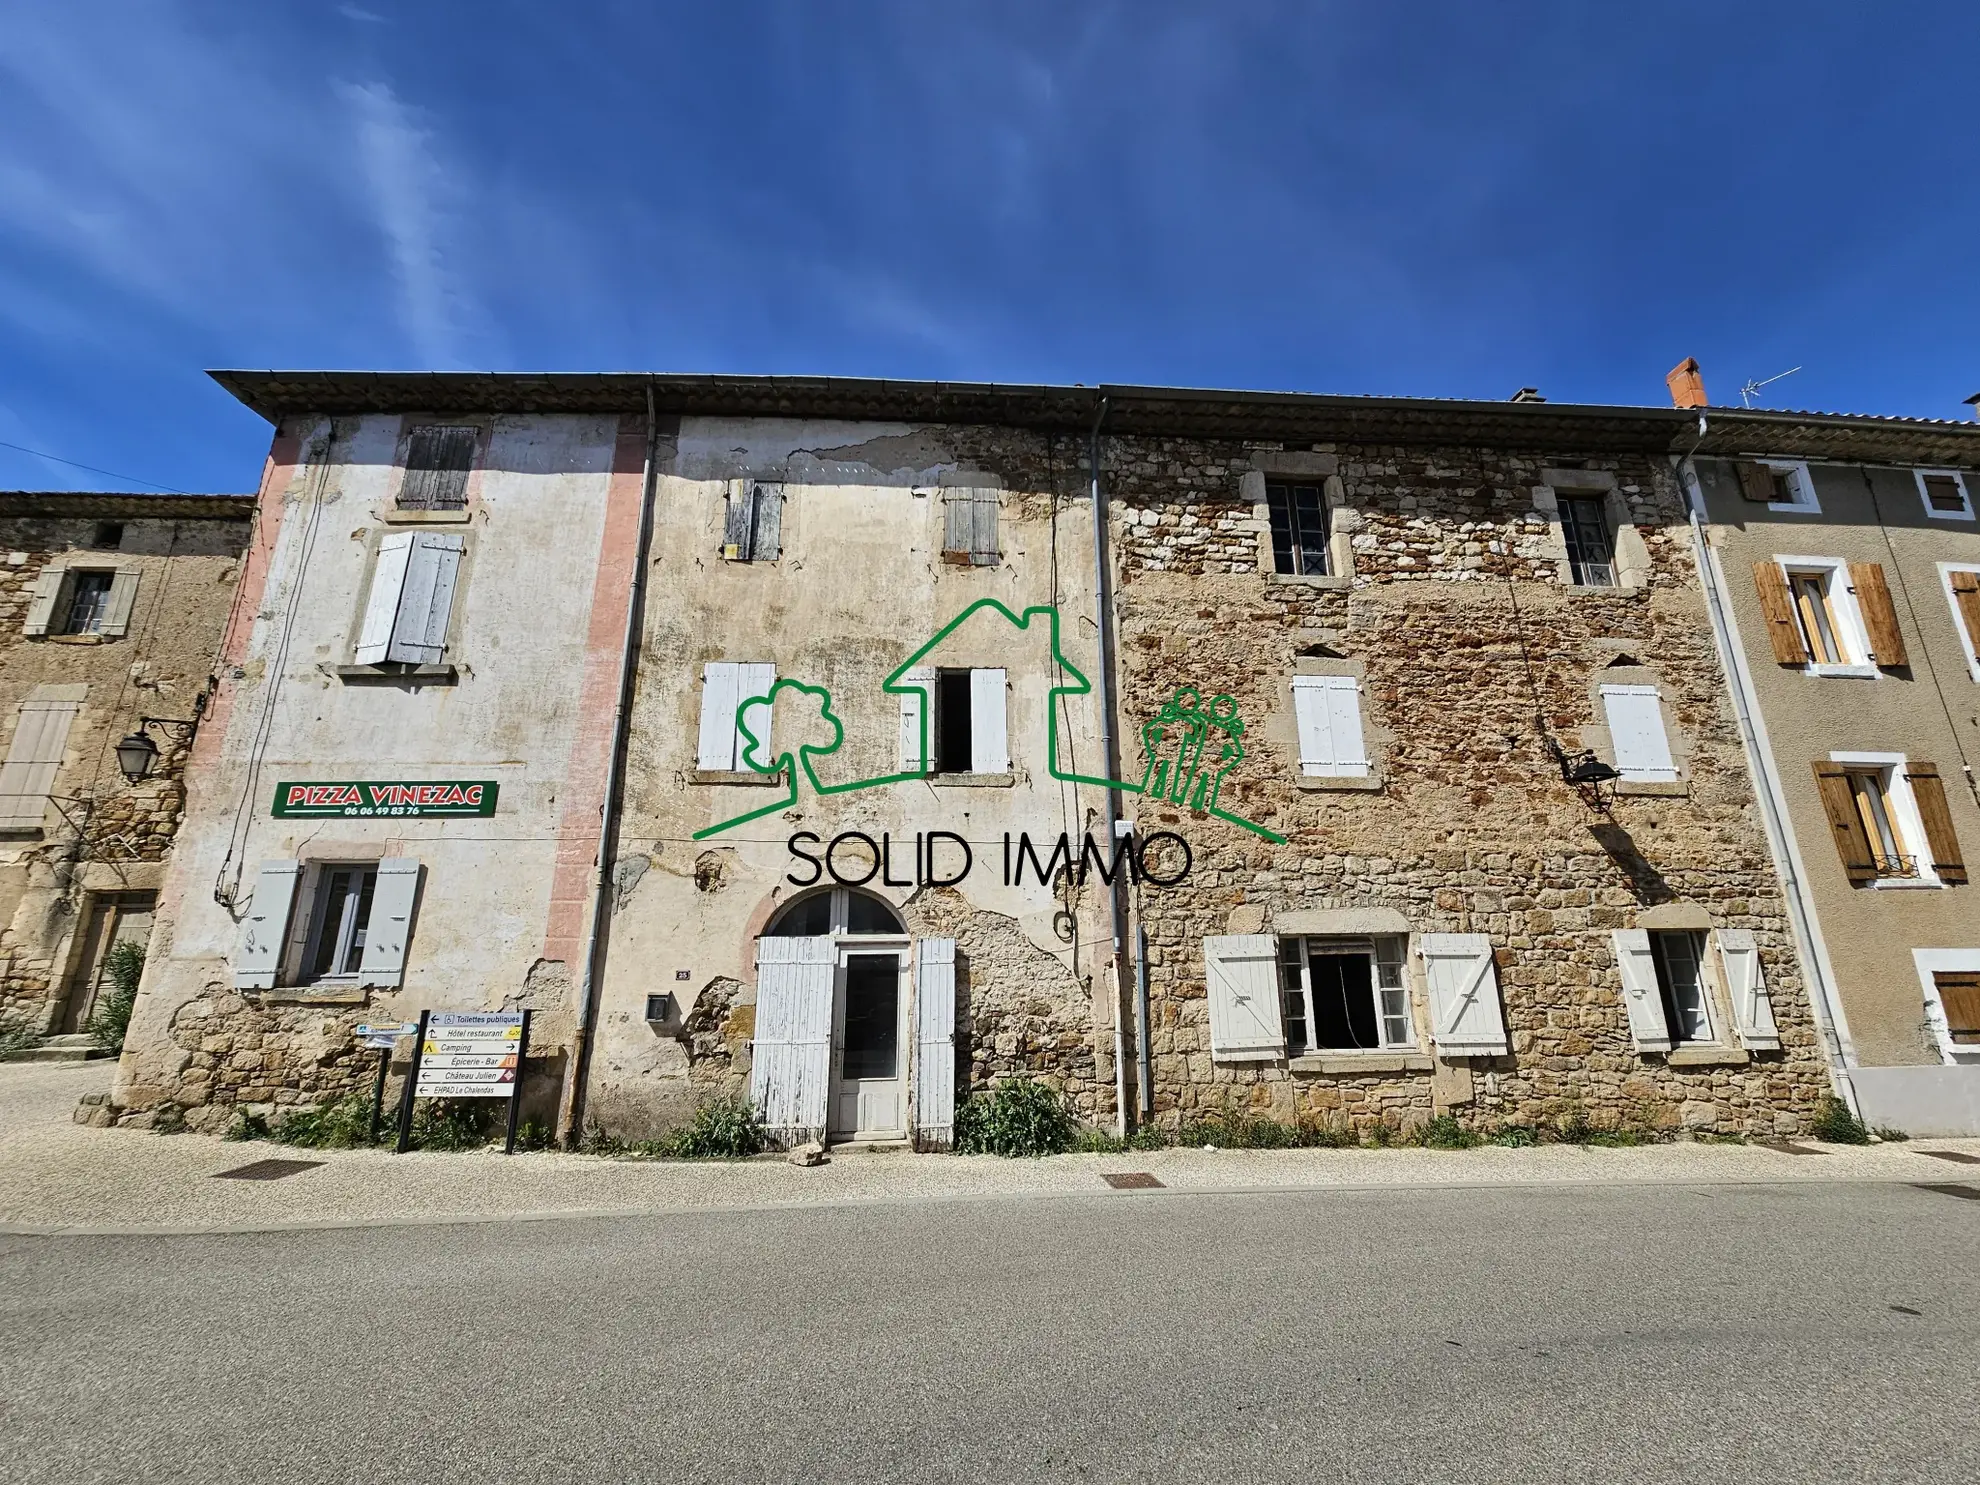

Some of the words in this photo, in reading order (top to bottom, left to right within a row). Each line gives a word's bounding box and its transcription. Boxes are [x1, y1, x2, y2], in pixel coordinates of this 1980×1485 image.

[287, 785, 363, 806] PIZZA
[369, 784, 483, 806] VINEZAC
[344, 807, 358, 815] 06
[360, 807, 374, 815] 06
[375, 807, 389, 815] 49
[390, 807, 404, 815] 83
[406, 807, 420, 815] 76
[456, 1015, 485, 1023] Toilettes
[486, 1015, 520, 1025] publiques
[447, 1029, 466, 1037] Hôtel
[440, 1043, 472, 1052] Camping
[451, 1057, 480, 1066] Épicerie
[485, 1057, 499, 1065] Bar
[445, 1071, 474, 1079] Château
[433, 1086, 455, 1094] EHPAD
[463, 1086, 494, 1094] Chalendas
